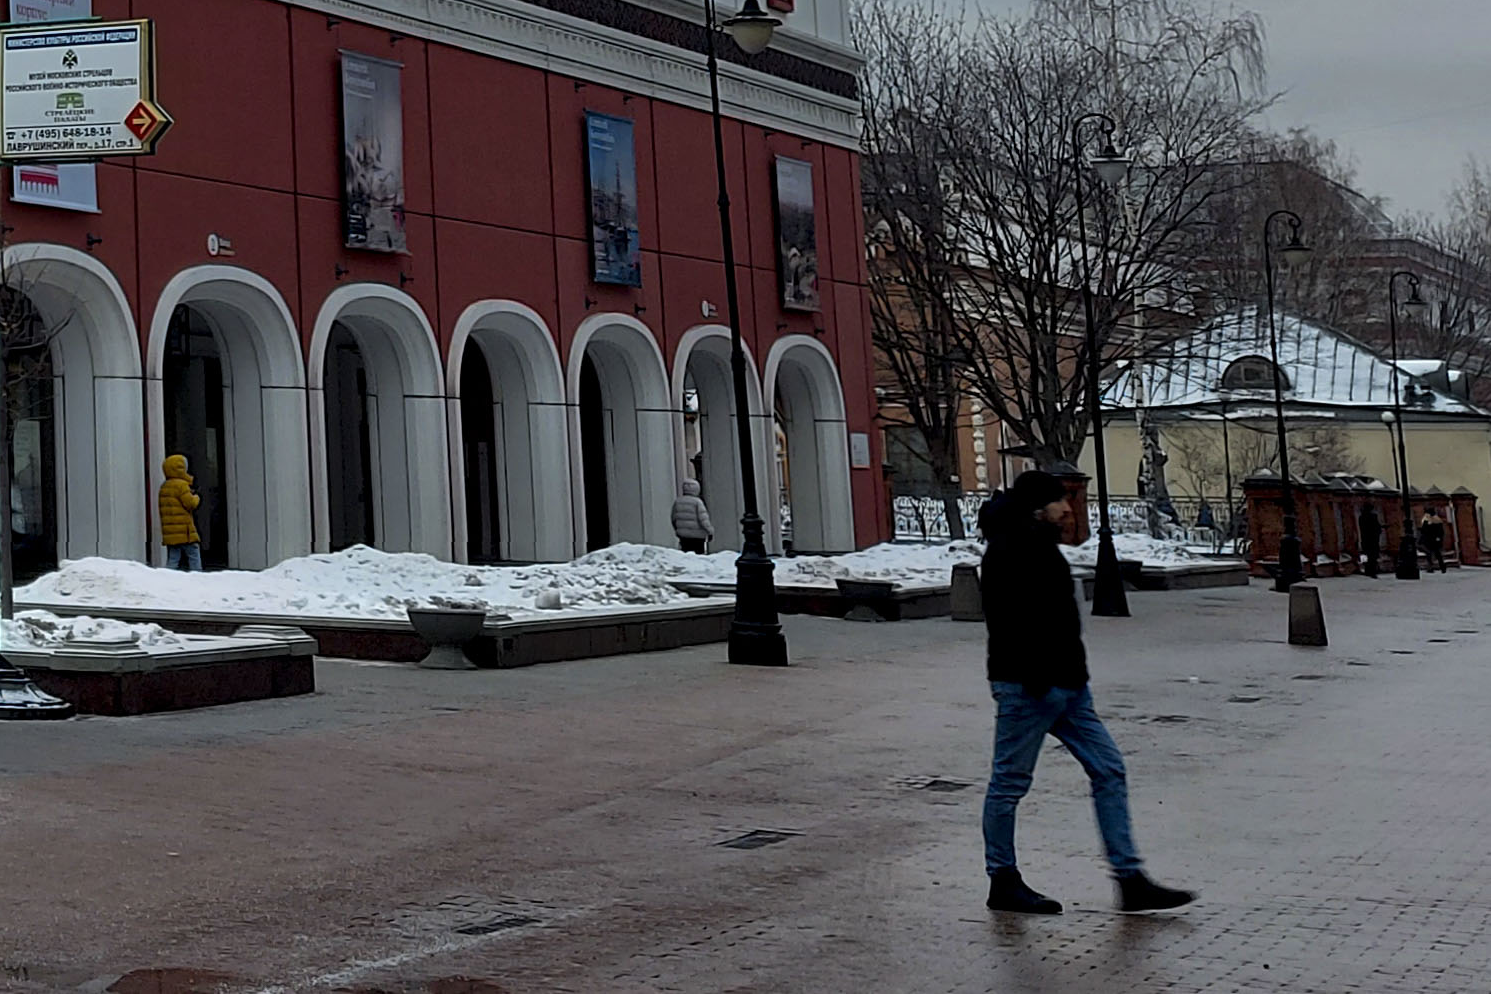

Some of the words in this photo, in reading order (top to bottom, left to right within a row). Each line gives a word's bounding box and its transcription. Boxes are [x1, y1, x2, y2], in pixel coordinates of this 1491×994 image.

[16, 3, 48, 22] корпус
[71, 32, 105, 43] РОССИЙСКОЙ
[29, 72, 46, 80] МУЗЕЙ
[47, 70, 81, 79] МОСКОВСКИХ
[82, 68, 113, 77] СТРЕЛЬЦОВ
[6, 83, 42, 92] РОССИЙСКОГО
[107, 78, 137, 87] ОБЩЕСТВА
[44, 108, 95, 117] СТРЕЛЕЦКИЕ
[22, 131, 33, 139] +7
[35, 128, 61, 141] (495)
[62, 126, 112, 138] 648-18-14
[6, 138, 75, 152] ЛАВРУШИНСКИЙ
